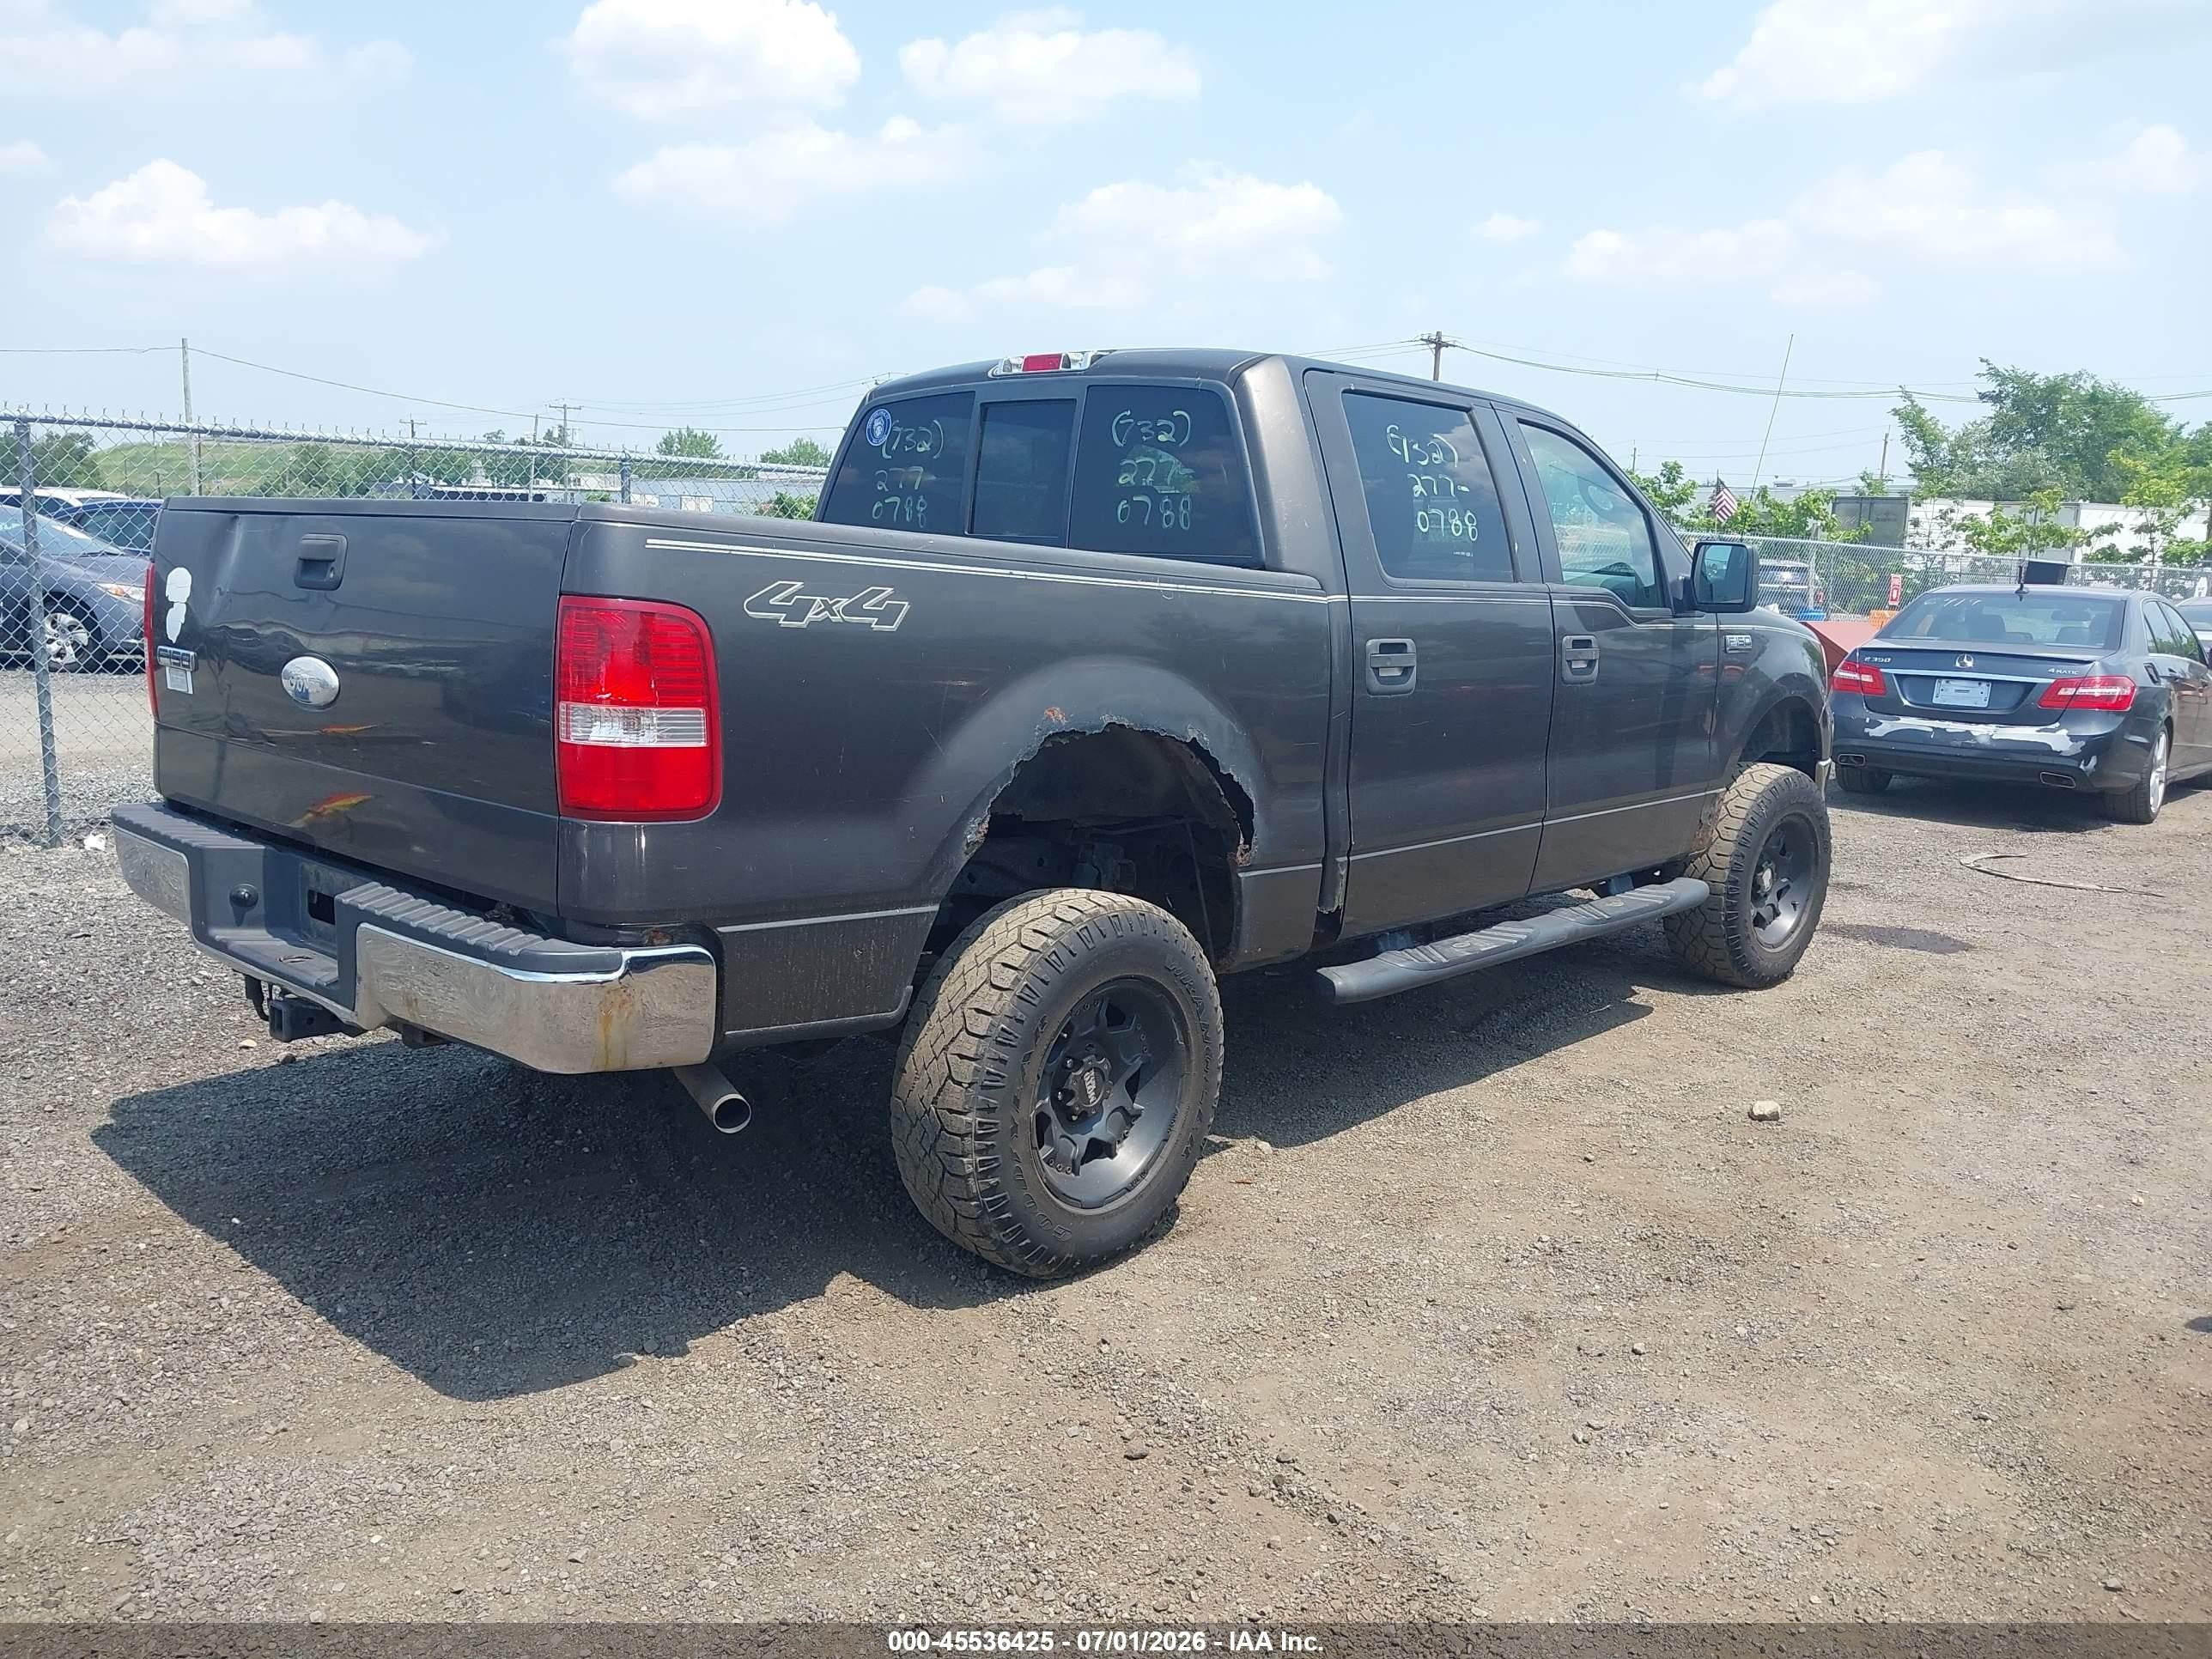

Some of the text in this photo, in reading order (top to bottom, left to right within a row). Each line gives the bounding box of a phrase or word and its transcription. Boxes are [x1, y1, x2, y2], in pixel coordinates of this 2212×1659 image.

[1112, 410, 1190, 447] (732)
[872, 495, 927, 528] 0788
[1117, 495, 1192, 530] 0788
[1417, 505, 1478, 541] 0788
[744, 580, 911, 631] 4x4
